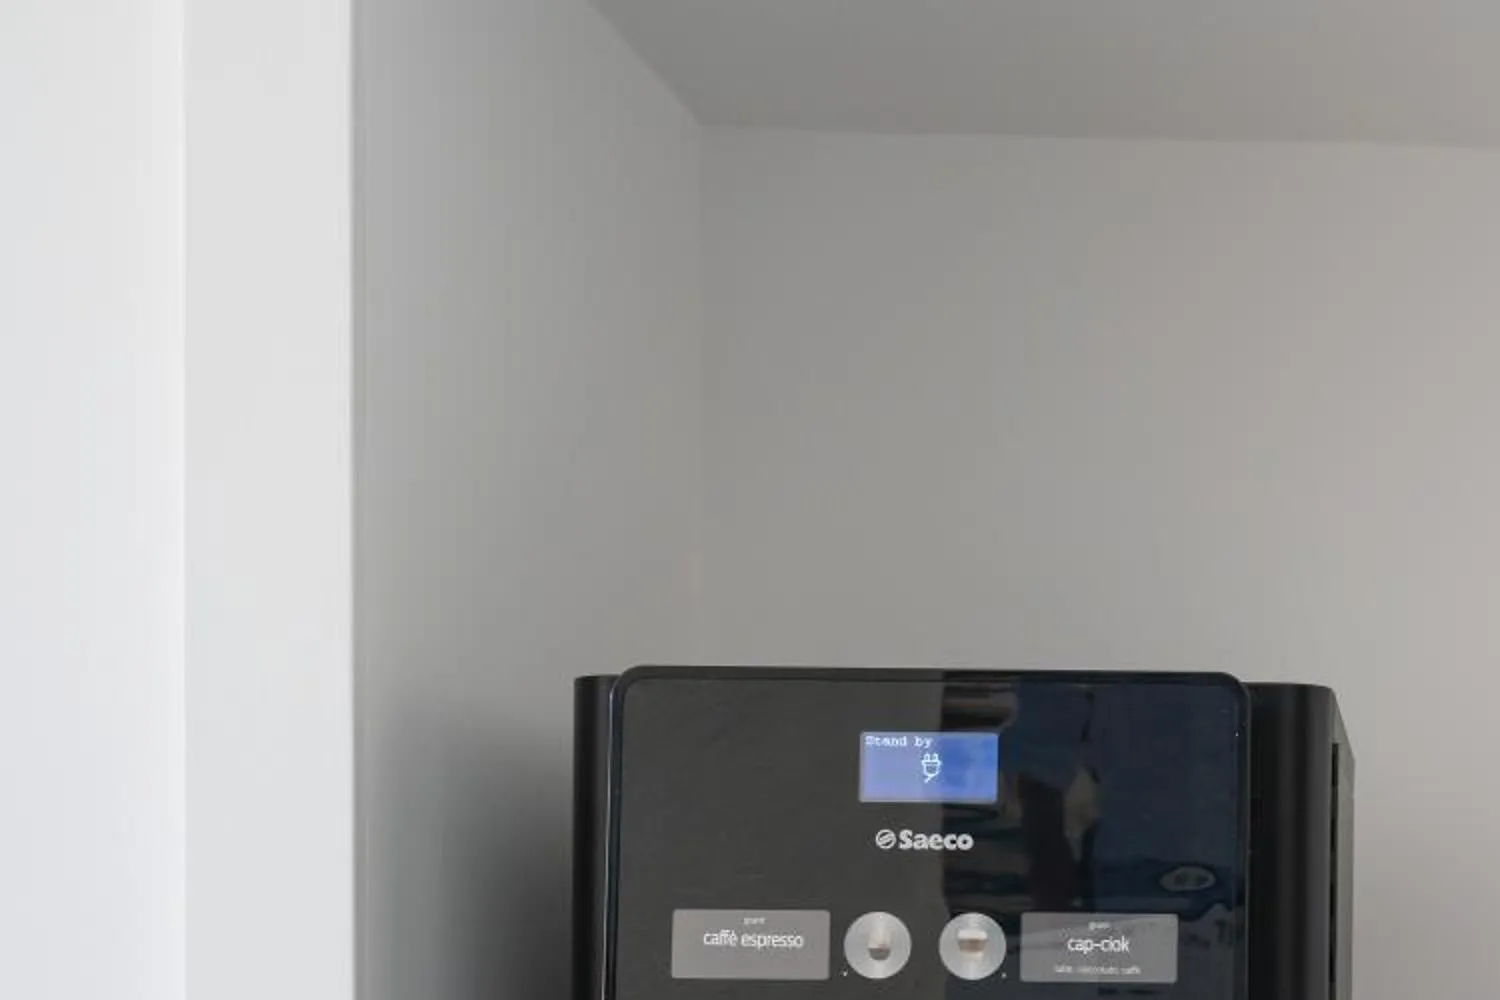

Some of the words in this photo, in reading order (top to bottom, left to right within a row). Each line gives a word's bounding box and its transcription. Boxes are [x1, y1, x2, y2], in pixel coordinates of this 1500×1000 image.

[865, 735, 907, 747] Stand
[914, 735, 933, 748] by
[898, 829, 974, 850] Saeco
[703, 929, 738, 947] caffè
[741, 932, 804, 949] espresso
